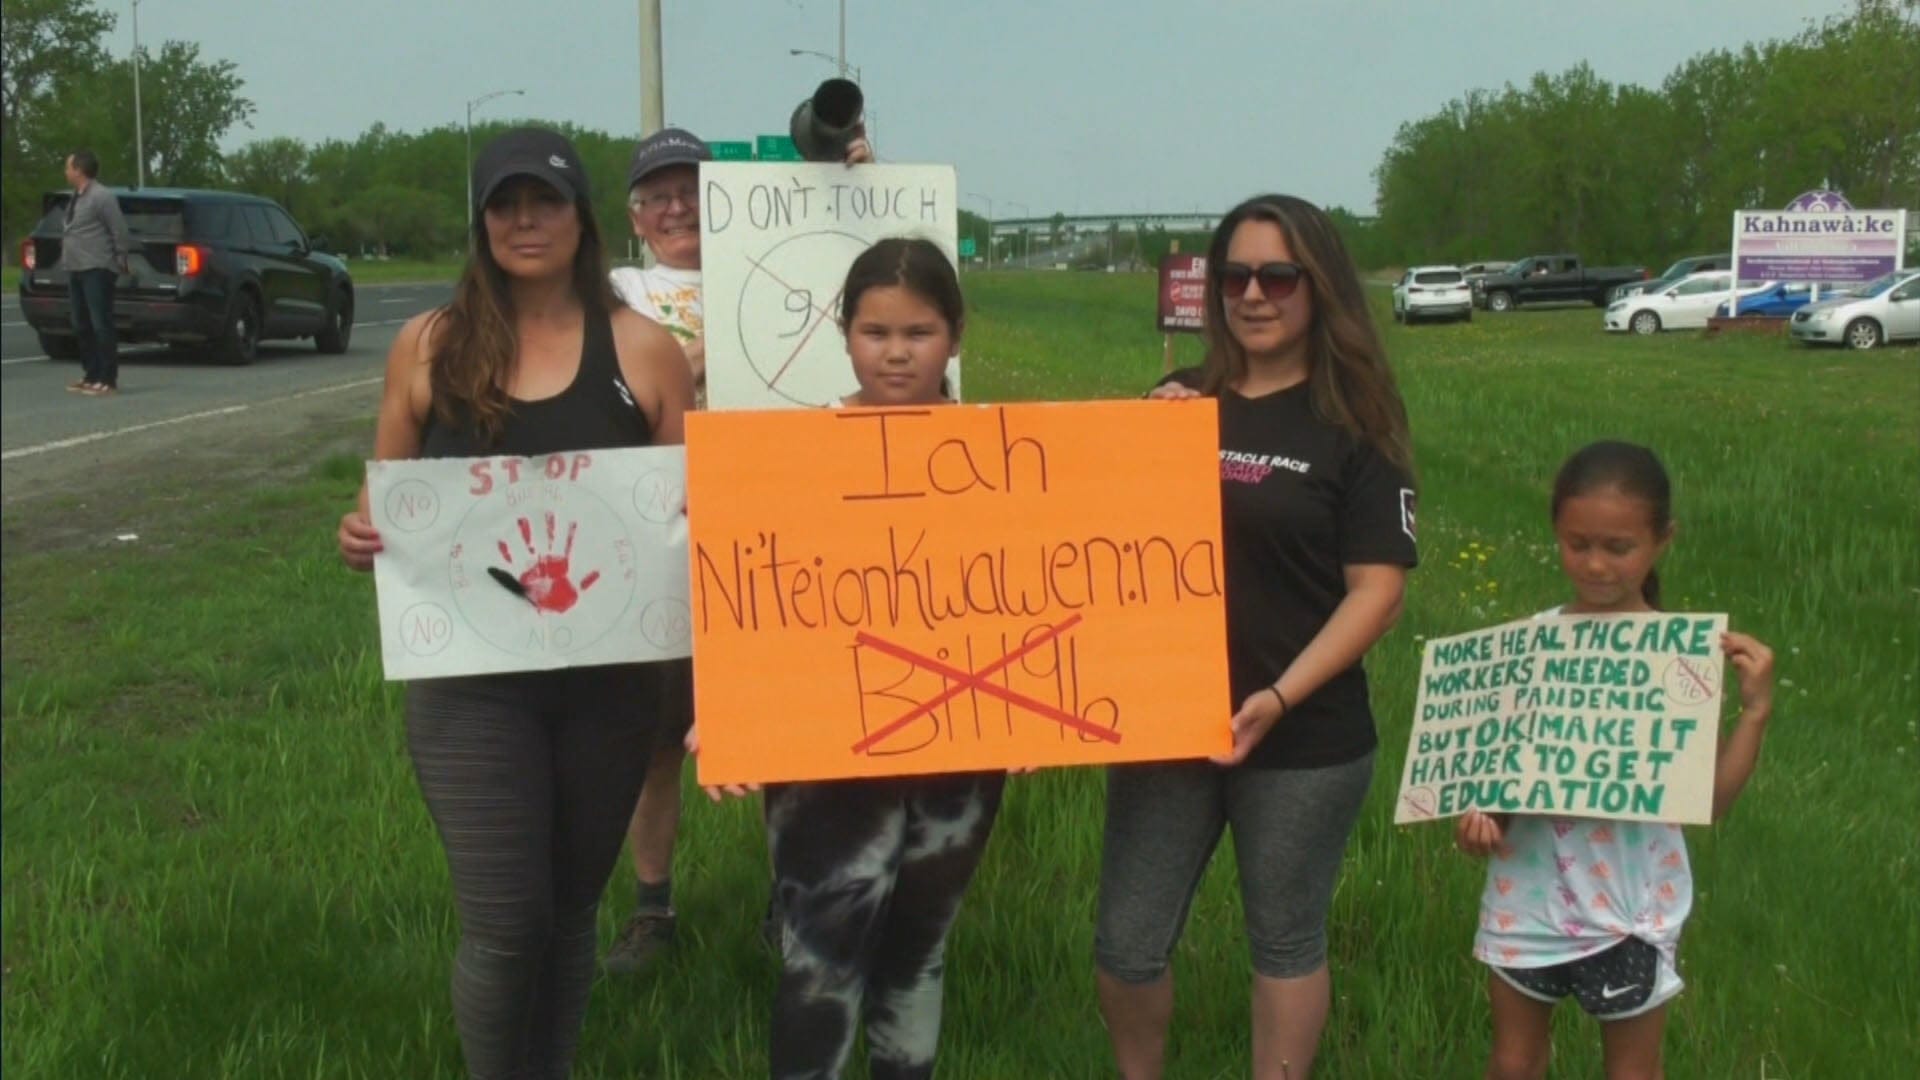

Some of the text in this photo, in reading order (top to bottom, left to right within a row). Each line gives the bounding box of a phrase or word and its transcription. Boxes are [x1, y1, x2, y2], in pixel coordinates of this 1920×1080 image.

[706, 177, 815, 233] DON'T
[1743, 214, 1894, 233] Kahnawà:ke
[835, 406, 1047, 500] Iah
[1270, 455, 1311, 473] RACE
[468, 453, 592, 496] STOP
[526, 625, 573, 651] NO
[1433, 633, 1494, 668] MORE
[846, 624, 1119, 756] Bill 96
[1425, 656, 1651, 698] WORKERS NEEDED
[1422, 686, 1666, 722] DURING PANDEMIC
[1417, 725, 1473, 755] BUT
[1537, 714, 1636, 748] MAKE
[1649, 718, 1698, 751] IT
[1410, 743, 1674, 786] HARDER TO GET
[1437, 779, 1666, 817] EDUCATION
